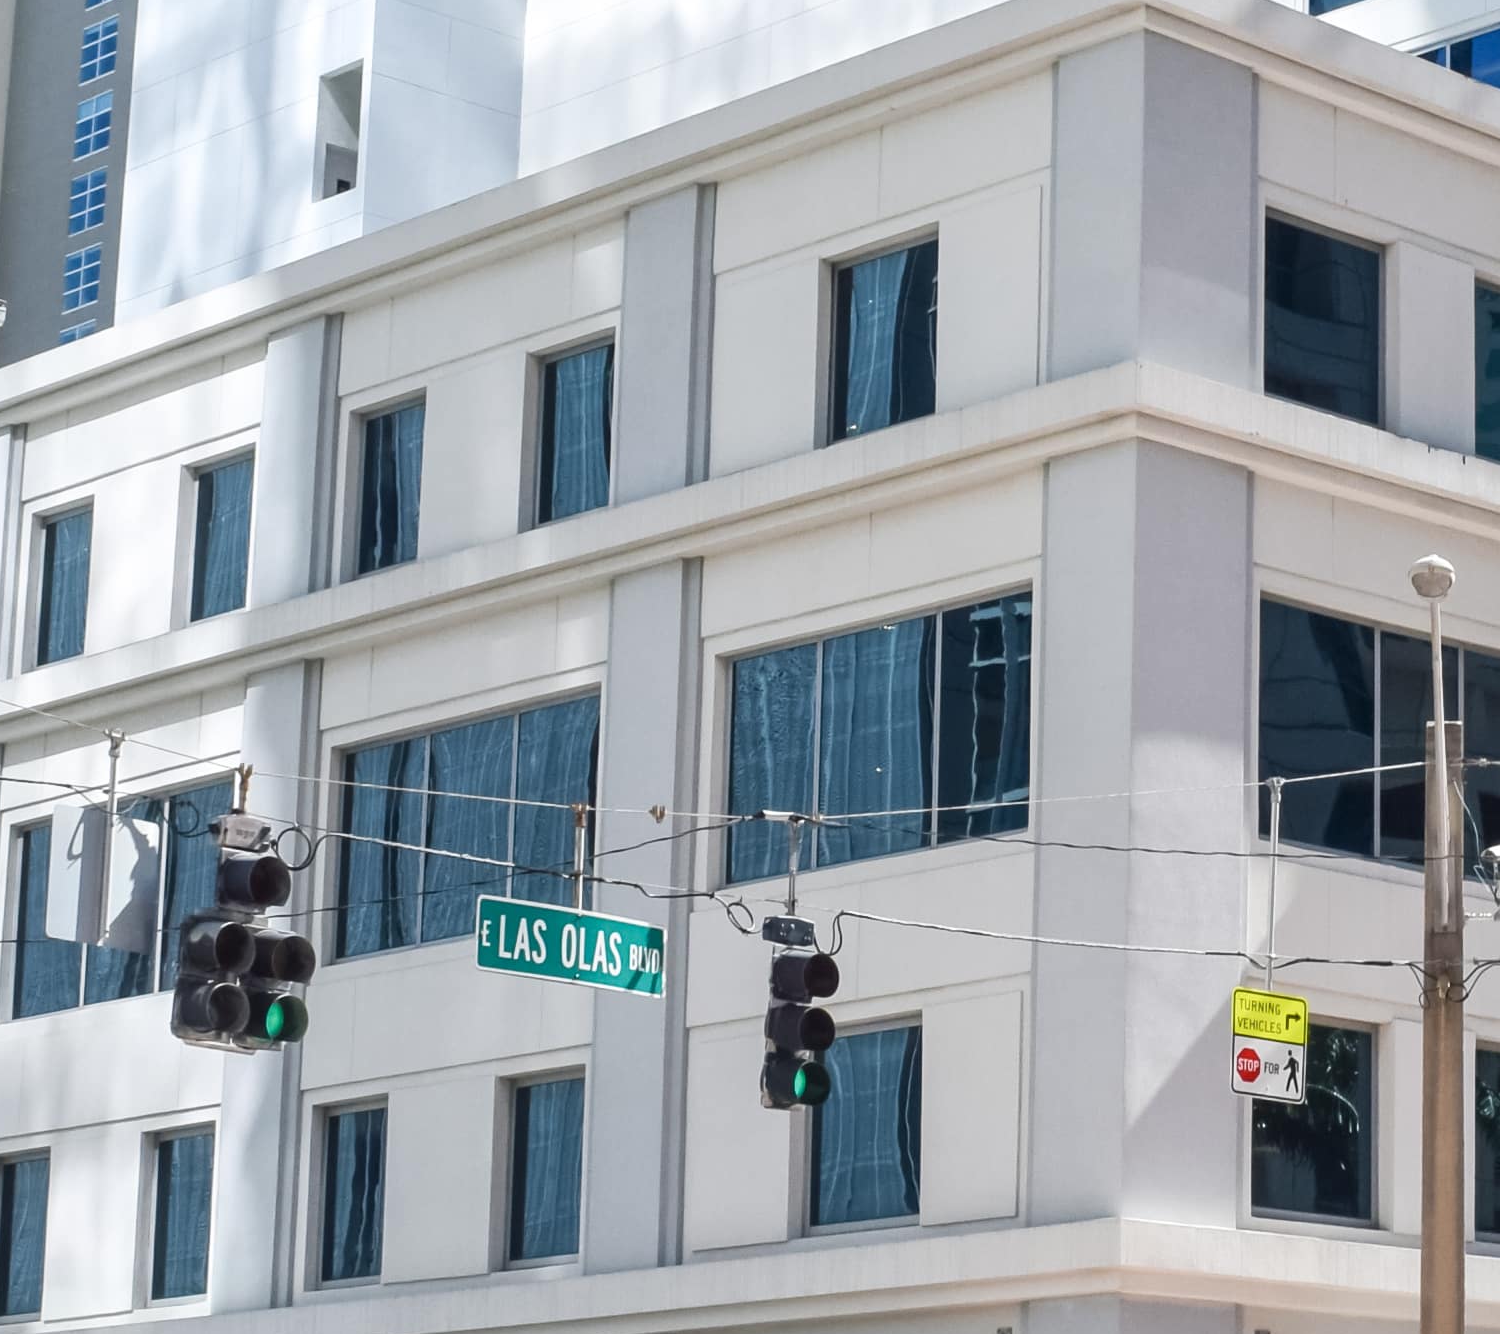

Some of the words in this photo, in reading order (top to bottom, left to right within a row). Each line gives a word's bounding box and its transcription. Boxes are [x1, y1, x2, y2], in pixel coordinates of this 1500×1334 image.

[481, 919, 492, 947] E
[498, 914, 548, 964] LAS
[561, 923, 622, 976] OLAS
[629, 944, 660, 974] BLVD
[1240, 998, 1281, 1015] TURNING
[1237, 1017, 1282, 1034] VEHICLES
[1238, 1058, 1259, 1072] STOP
[1264, 1062, 1280, 1074] FOR
